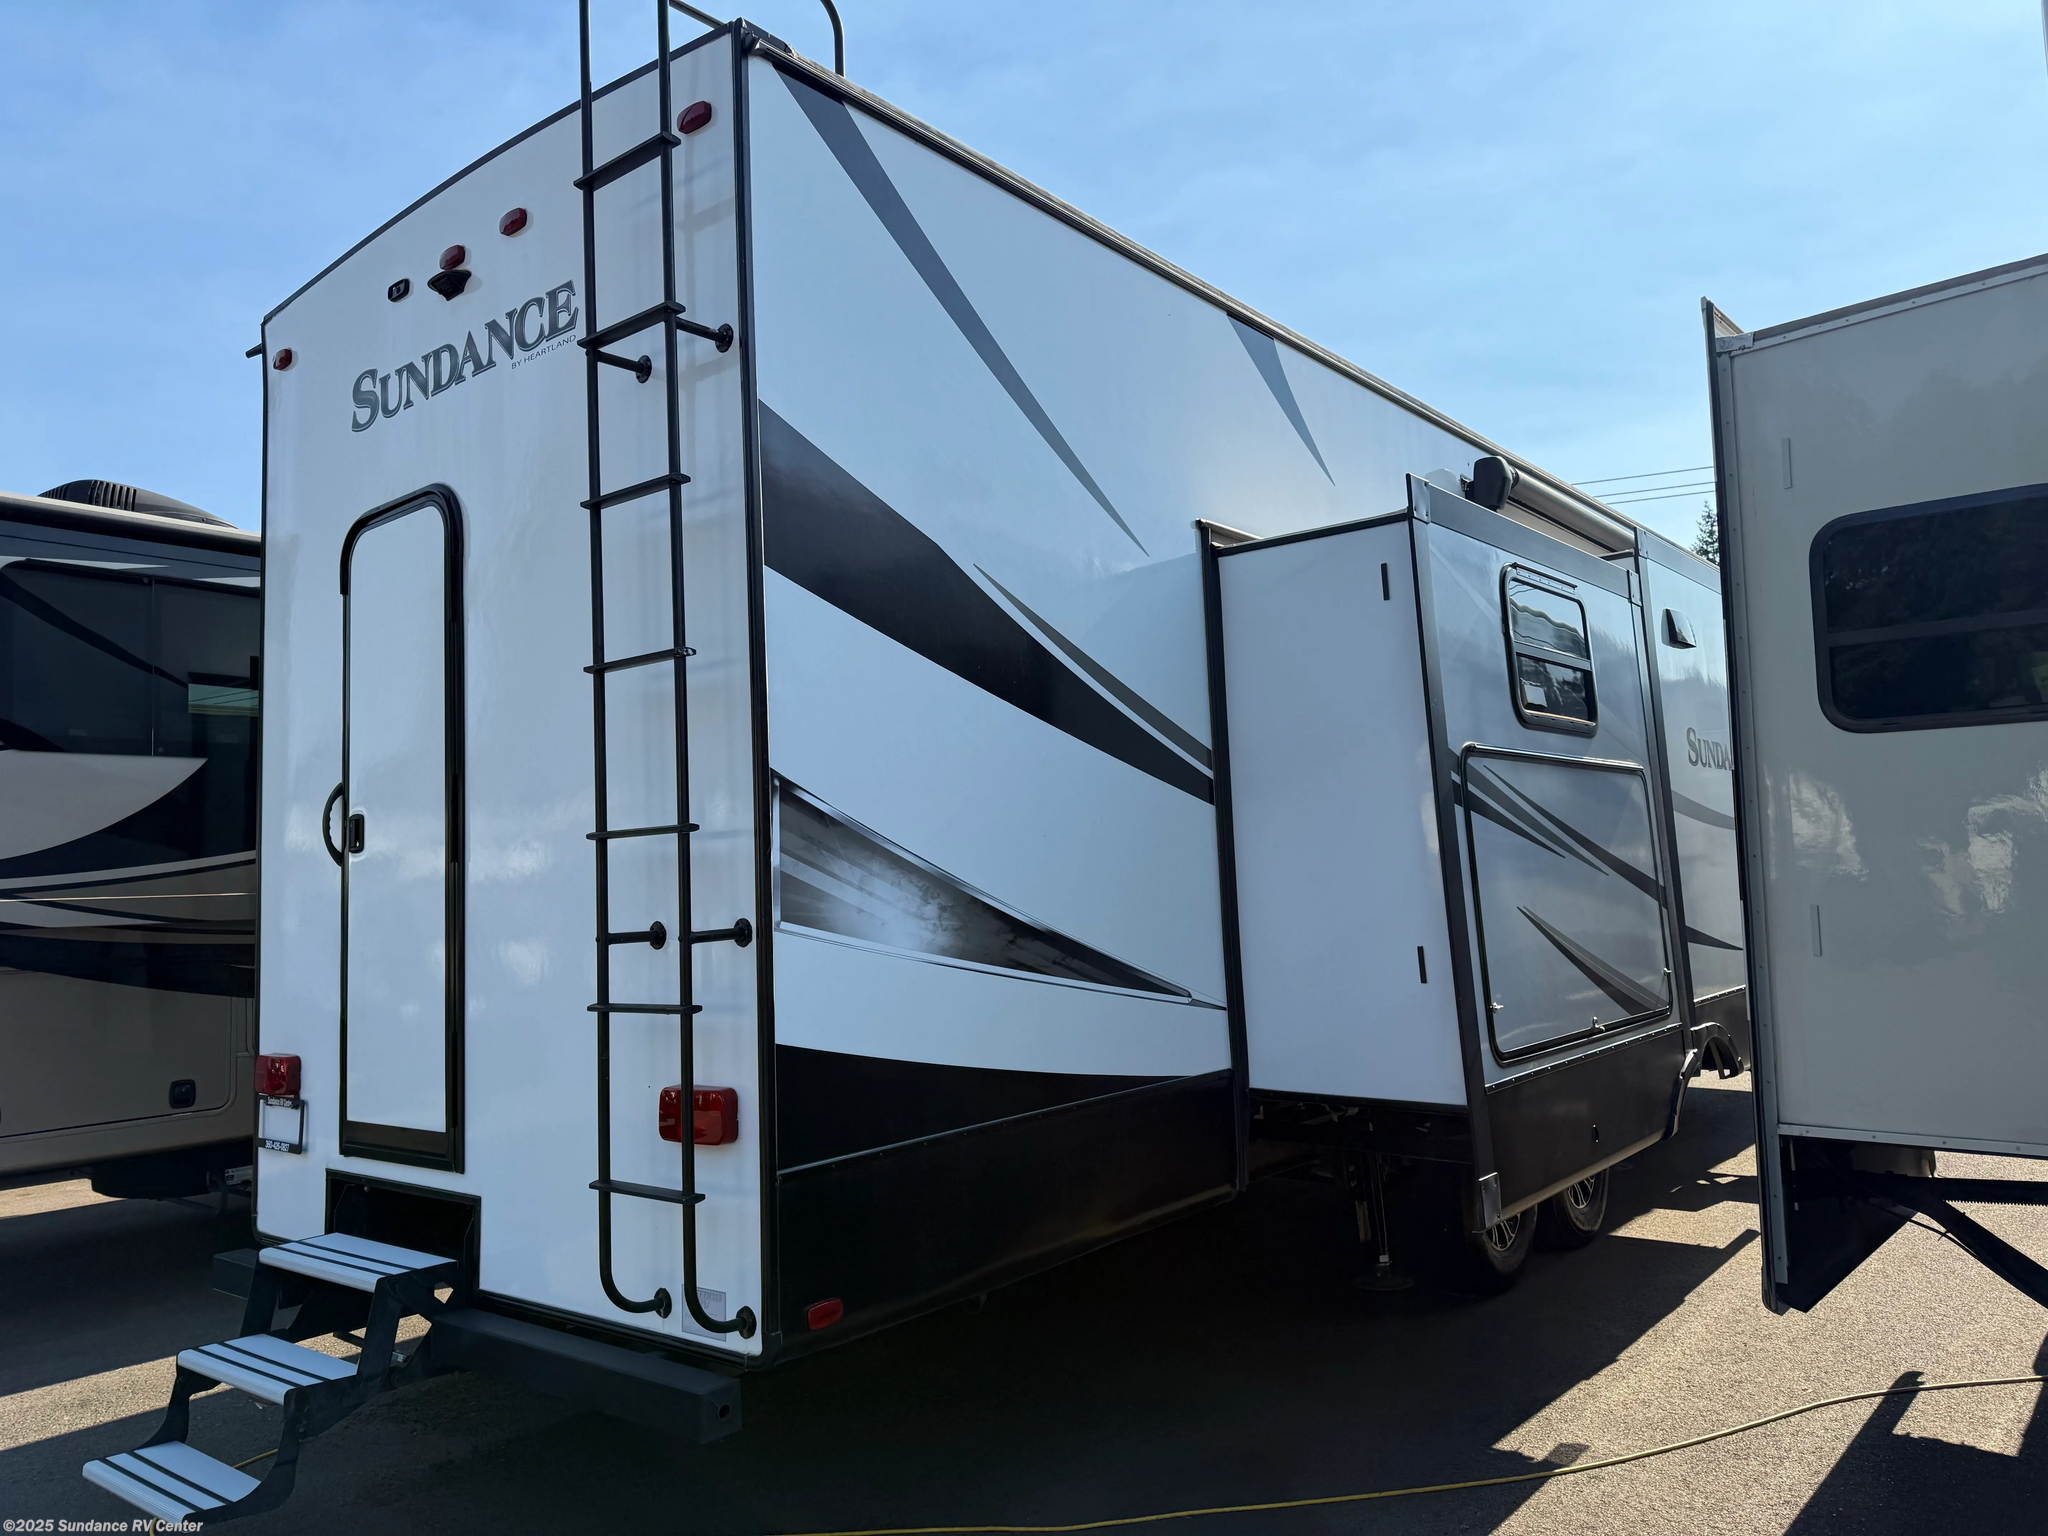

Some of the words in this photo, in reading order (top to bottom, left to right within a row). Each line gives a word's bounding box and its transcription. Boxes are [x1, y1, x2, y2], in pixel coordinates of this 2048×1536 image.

[351, 279, 579, 432] SUNDANCE
[511, 359, 523, 369] BY
[524, 334, 577, 363] HEARTLAND
